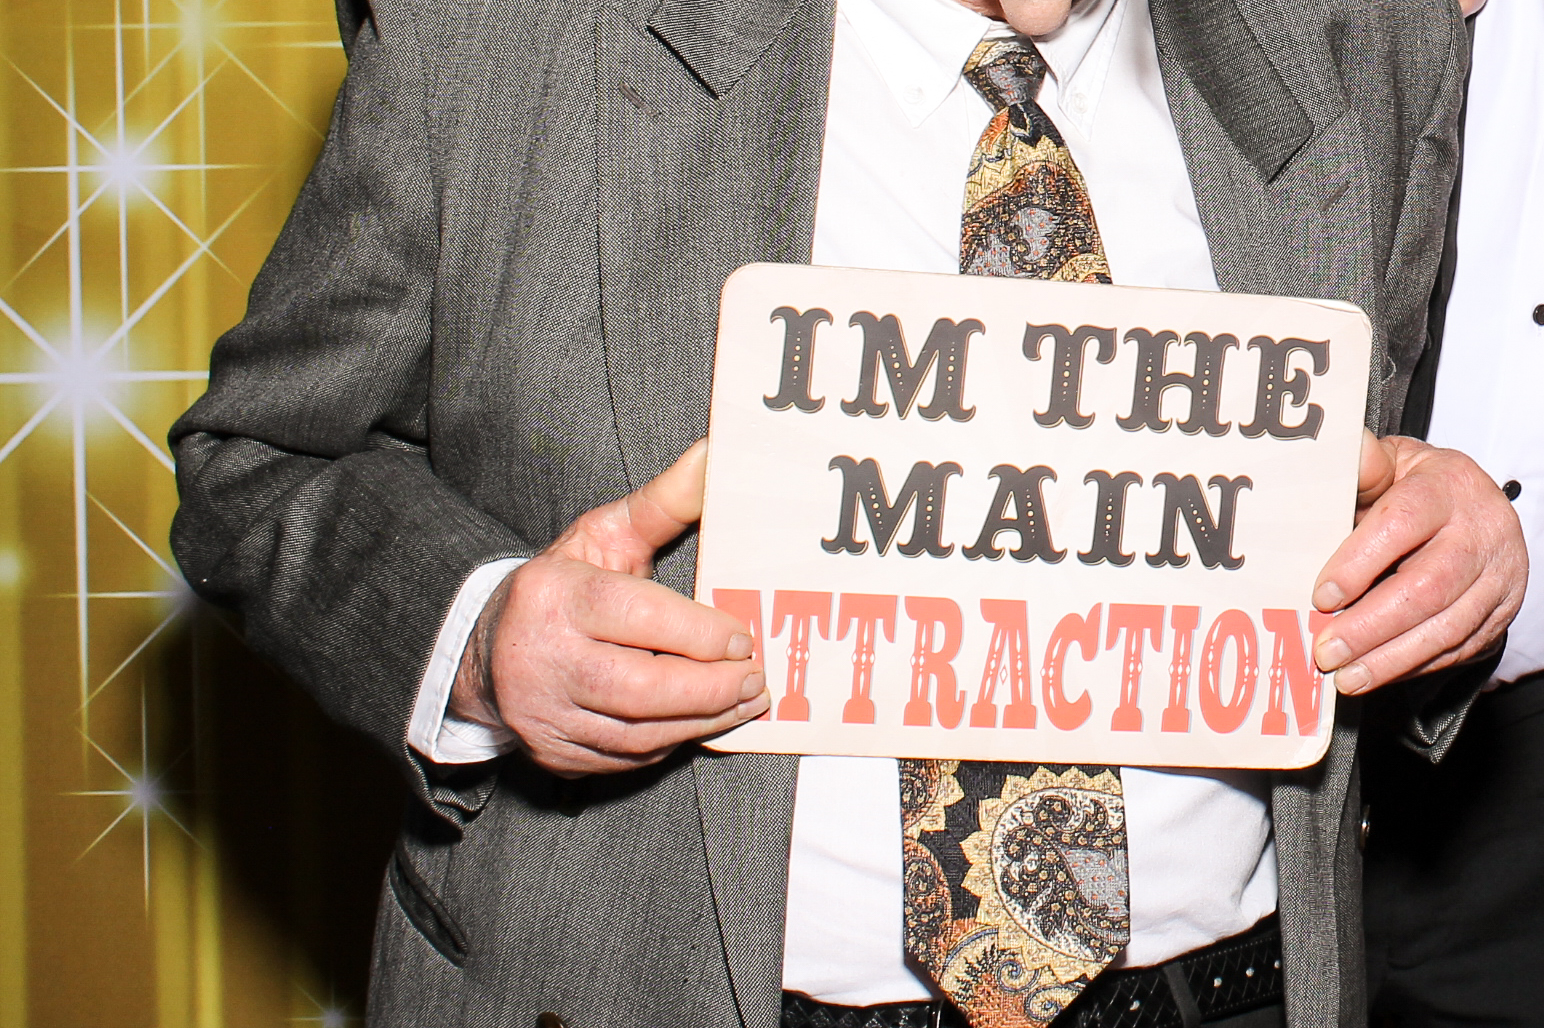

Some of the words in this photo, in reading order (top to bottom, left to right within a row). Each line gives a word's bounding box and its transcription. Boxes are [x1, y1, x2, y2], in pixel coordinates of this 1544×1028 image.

[762, 305, 987, 423] IM
[1021, 321, 1332, 441] THE
[819, 454, 1255, 572] MAIN
